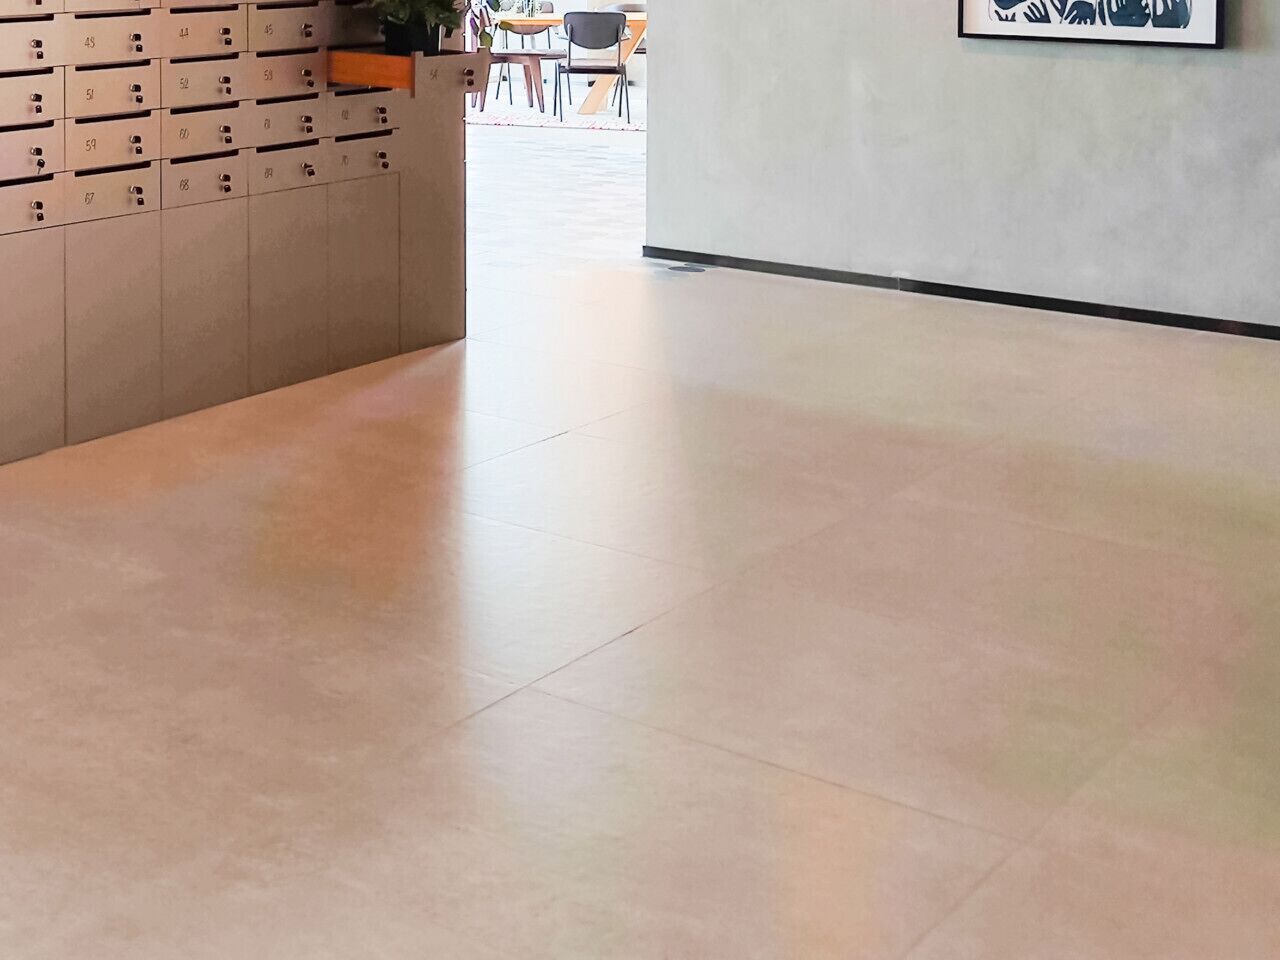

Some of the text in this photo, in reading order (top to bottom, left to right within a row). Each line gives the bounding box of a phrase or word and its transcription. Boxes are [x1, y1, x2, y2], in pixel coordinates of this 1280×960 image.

[84, 35, 96, 49] 43
[179, 77, 189, 90] 52
[86, 88, 95, 101] 51
[85, 138, 97, 152] 59
[179, 178, 190, 192] 68
[84, 191, 95, 206] 67
